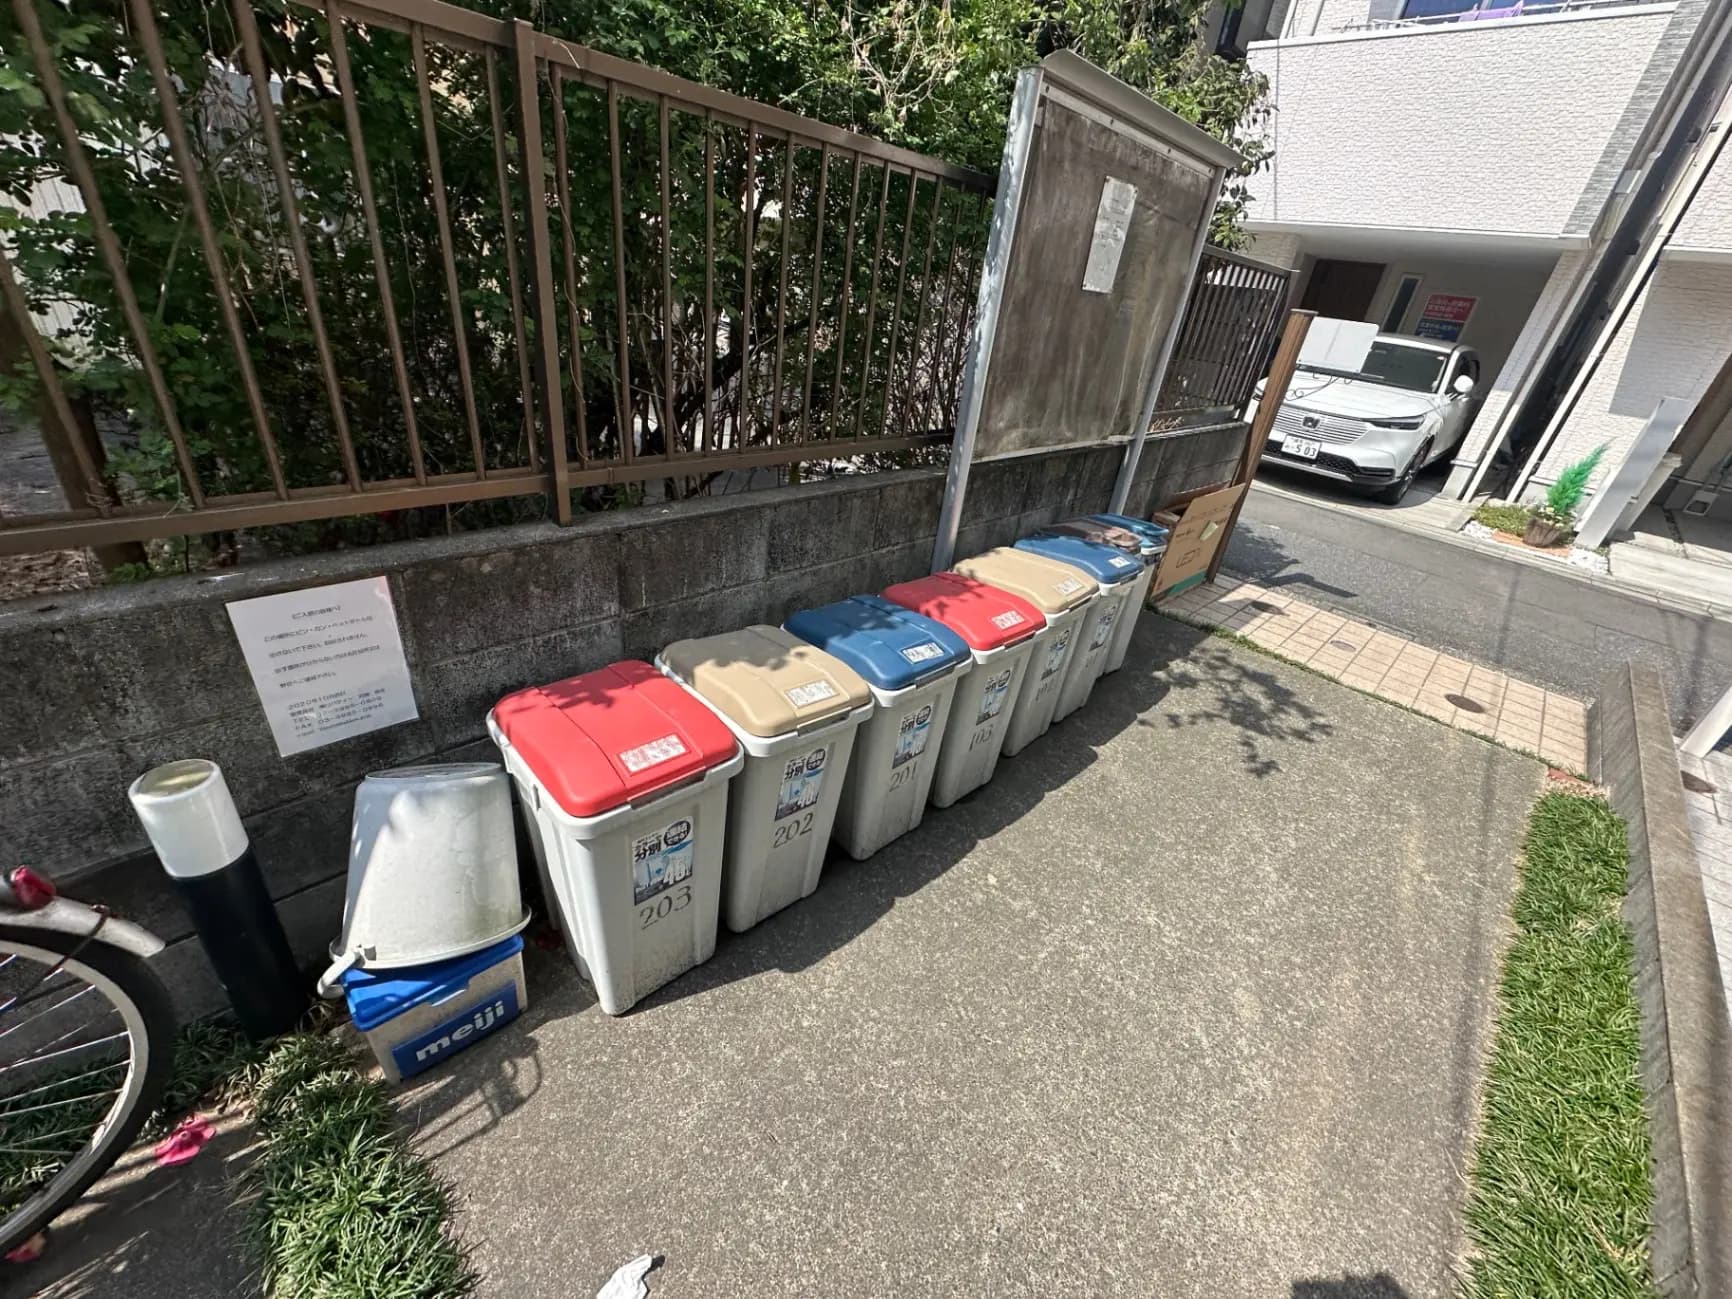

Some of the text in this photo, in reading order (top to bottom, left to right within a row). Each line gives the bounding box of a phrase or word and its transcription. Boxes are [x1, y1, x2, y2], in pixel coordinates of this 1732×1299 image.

[773, 812, 813, 849] 202
[640, 885, 692, 930] 203
[415, 1000, 505, 1062] meiji
